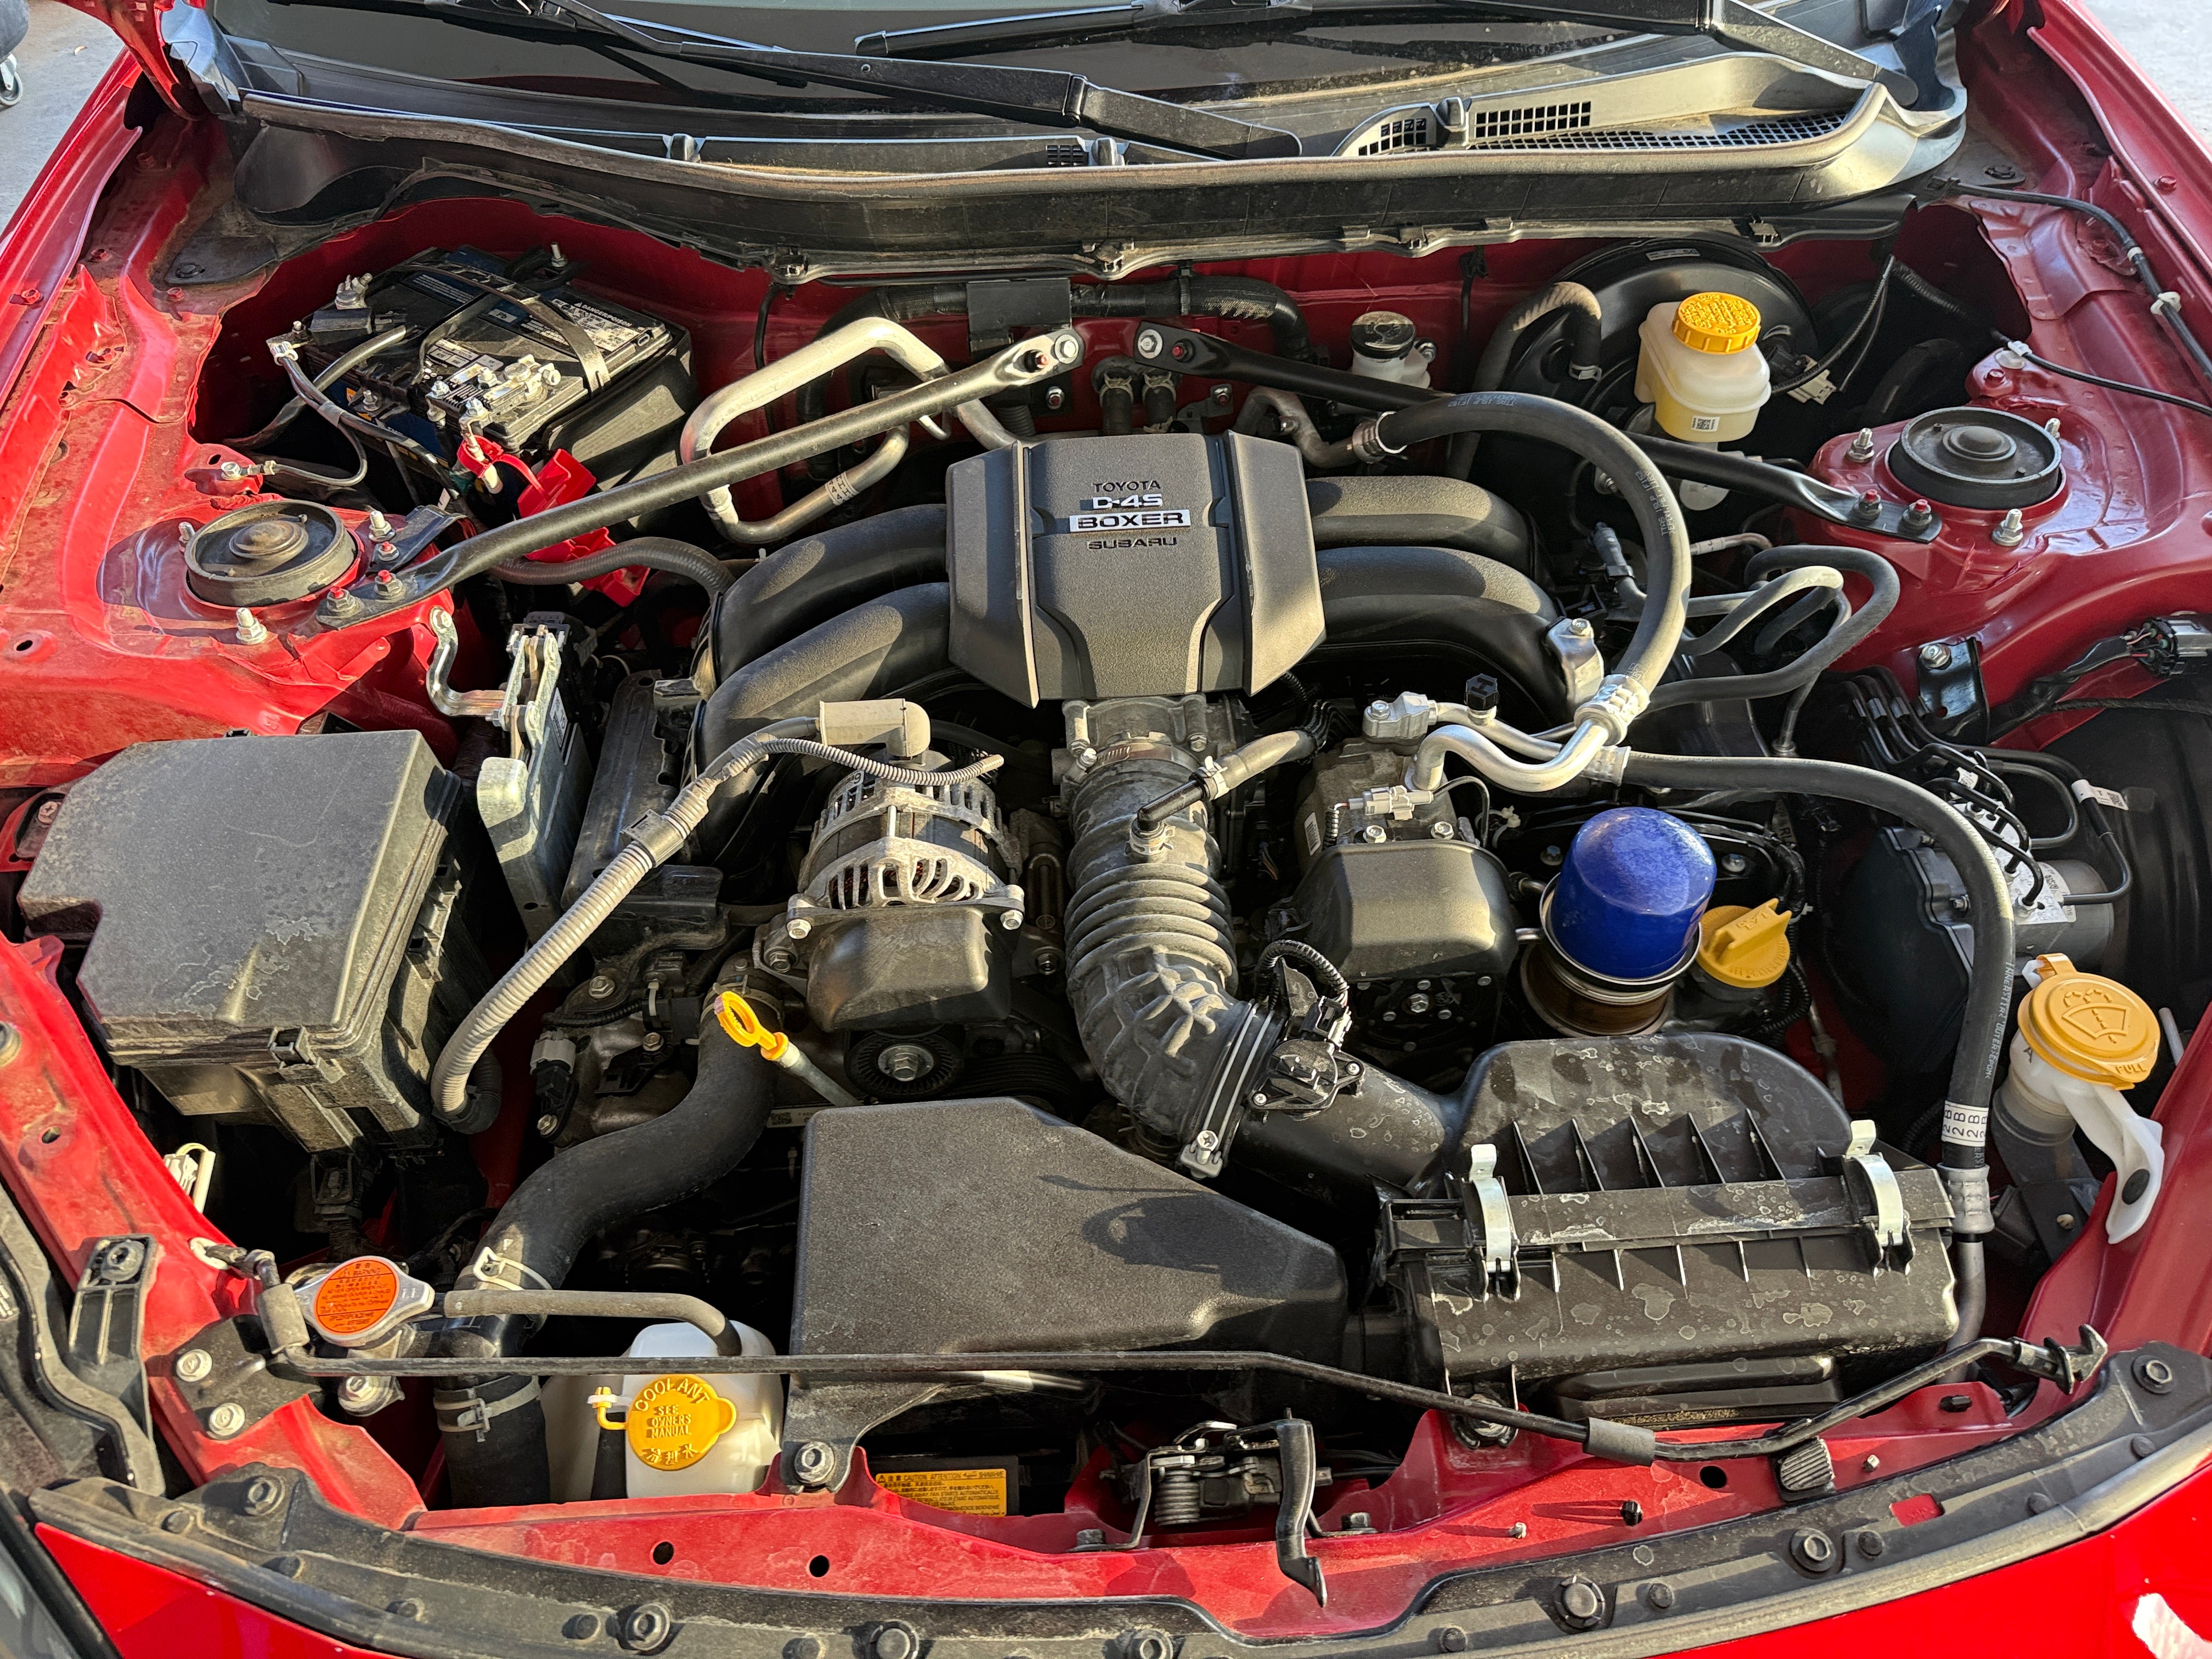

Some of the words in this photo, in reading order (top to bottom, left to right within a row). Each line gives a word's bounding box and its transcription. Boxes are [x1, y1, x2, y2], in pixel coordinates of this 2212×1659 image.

[1093, 479, 1161, 493] TOYOTA
[1077, 512, 1183, 530] BOXER
[1088, 537, 1178, 550] SUBARU
[2114, 1062, 2148, 1075] PULL
[1951, 1111, 1966, 1137] 2B
[1966, 1115, 1980, 1138] 2B
[635, 1378, 710, 1412] COOLANT
[657, 1404, 679, 1415] SEE
[651, 1425, 692, 1439] MANUAL
